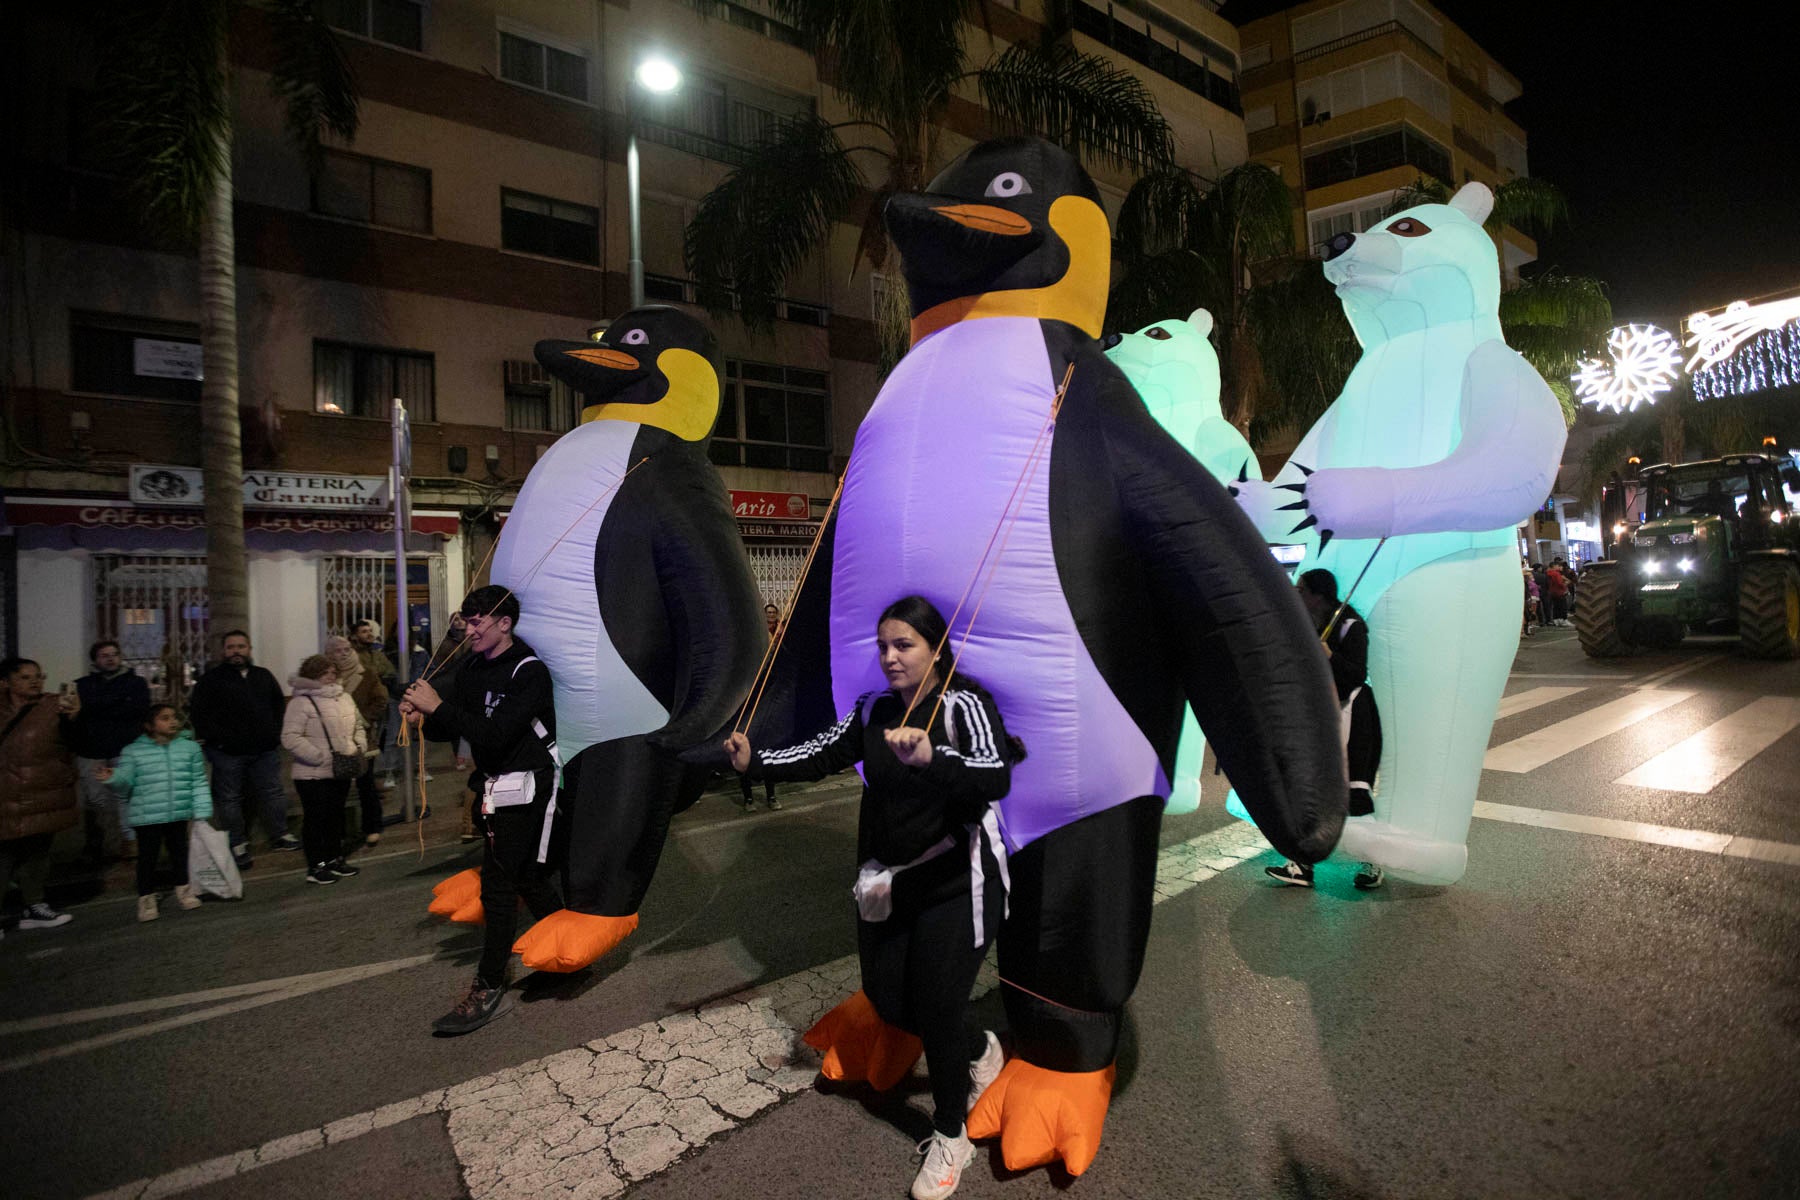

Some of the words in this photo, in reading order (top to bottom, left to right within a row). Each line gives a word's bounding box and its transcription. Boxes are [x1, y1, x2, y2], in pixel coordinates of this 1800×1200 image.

[241, 475, 366, 491] AFETERIA
[254, 488, 381, 505] Caramba
[79, 507, 208, 525] CAFETER
[297, 514, 394, 529] CARAMB
[737, 525, 775, 535] ETERIA
[780, 525, 817, 536] MARIO
